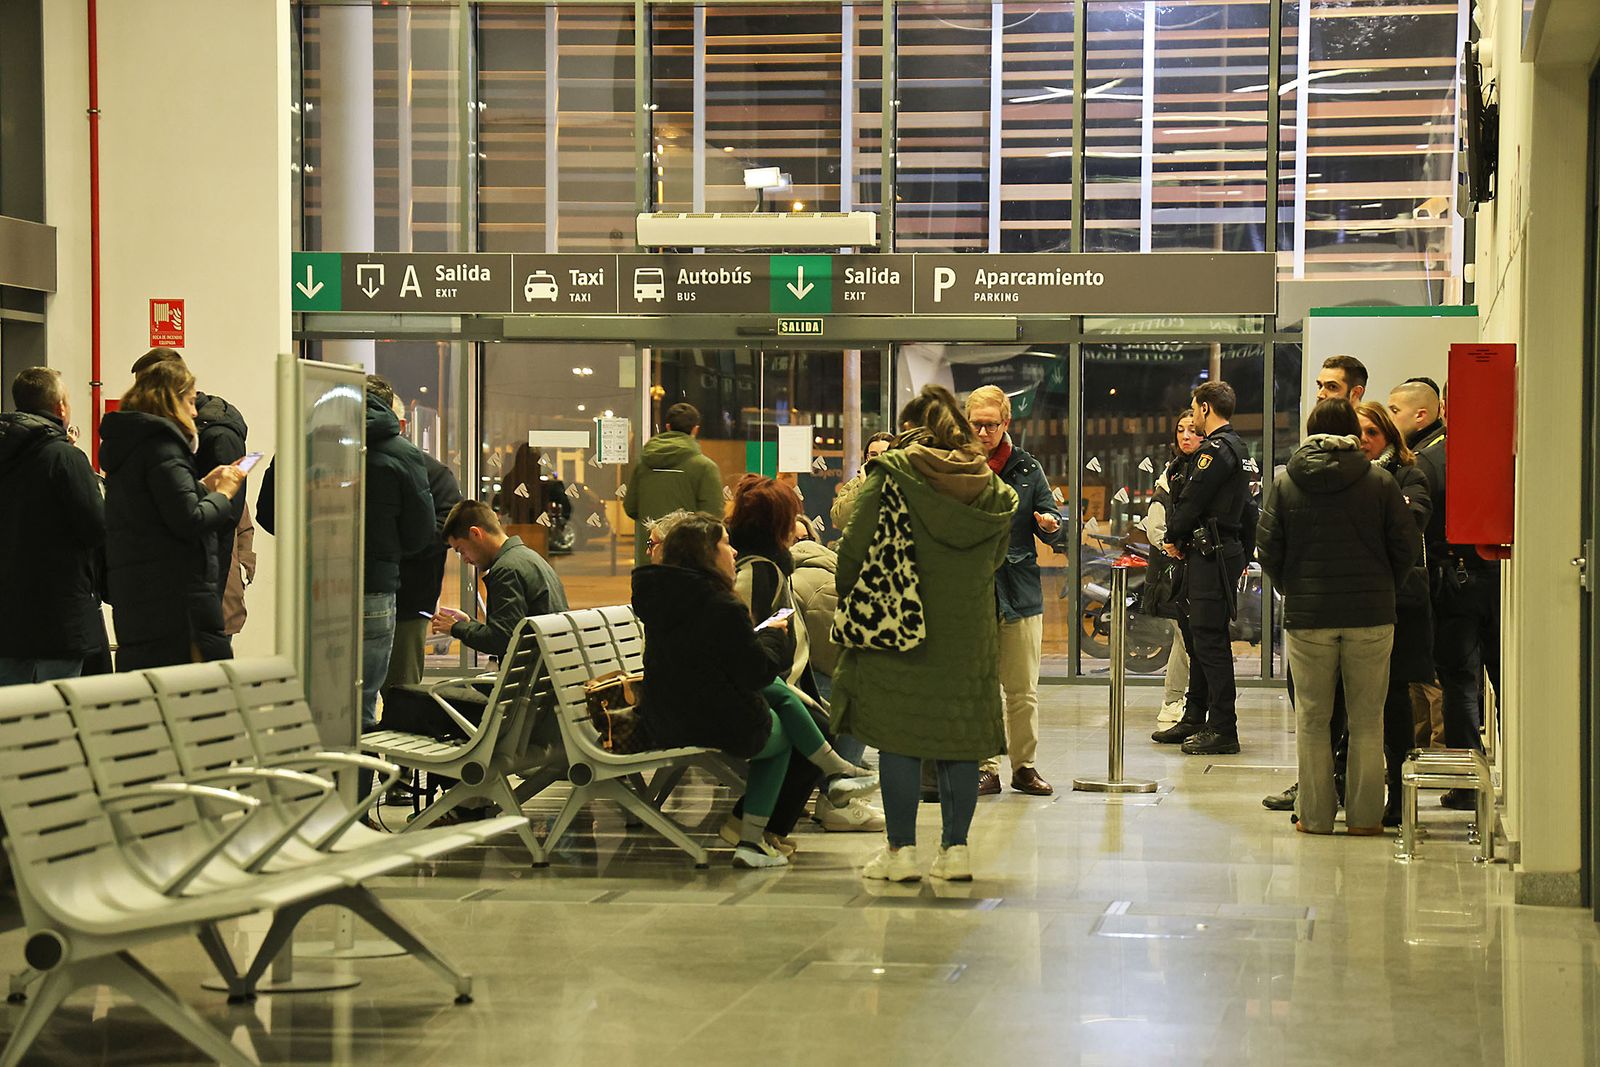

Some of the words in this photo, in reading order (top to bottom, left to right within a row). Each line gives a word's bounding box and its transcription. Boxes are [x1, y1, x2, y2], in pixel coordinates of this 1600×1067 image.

[398, 264, 422, 298] A
[435, 264, 491, 282] Salida
[568, 268, 604, 286] Taxi
[677, 266, 752, 285] Autobús
[844, 267, 900, 285] Salida
[974, 268, 1105, 289] Aparcamiento
[435, 287, 458, 298] EXIT
[933, 266, 956, 303] P
[568, 292, 591, 303] TAXI
[677, 291, 696, 302] BUS
[844, 291, 866, 301] EXIT
[974, 292, 1019, 302] PARKING
[781, 321, 819, 332] SALIDA
